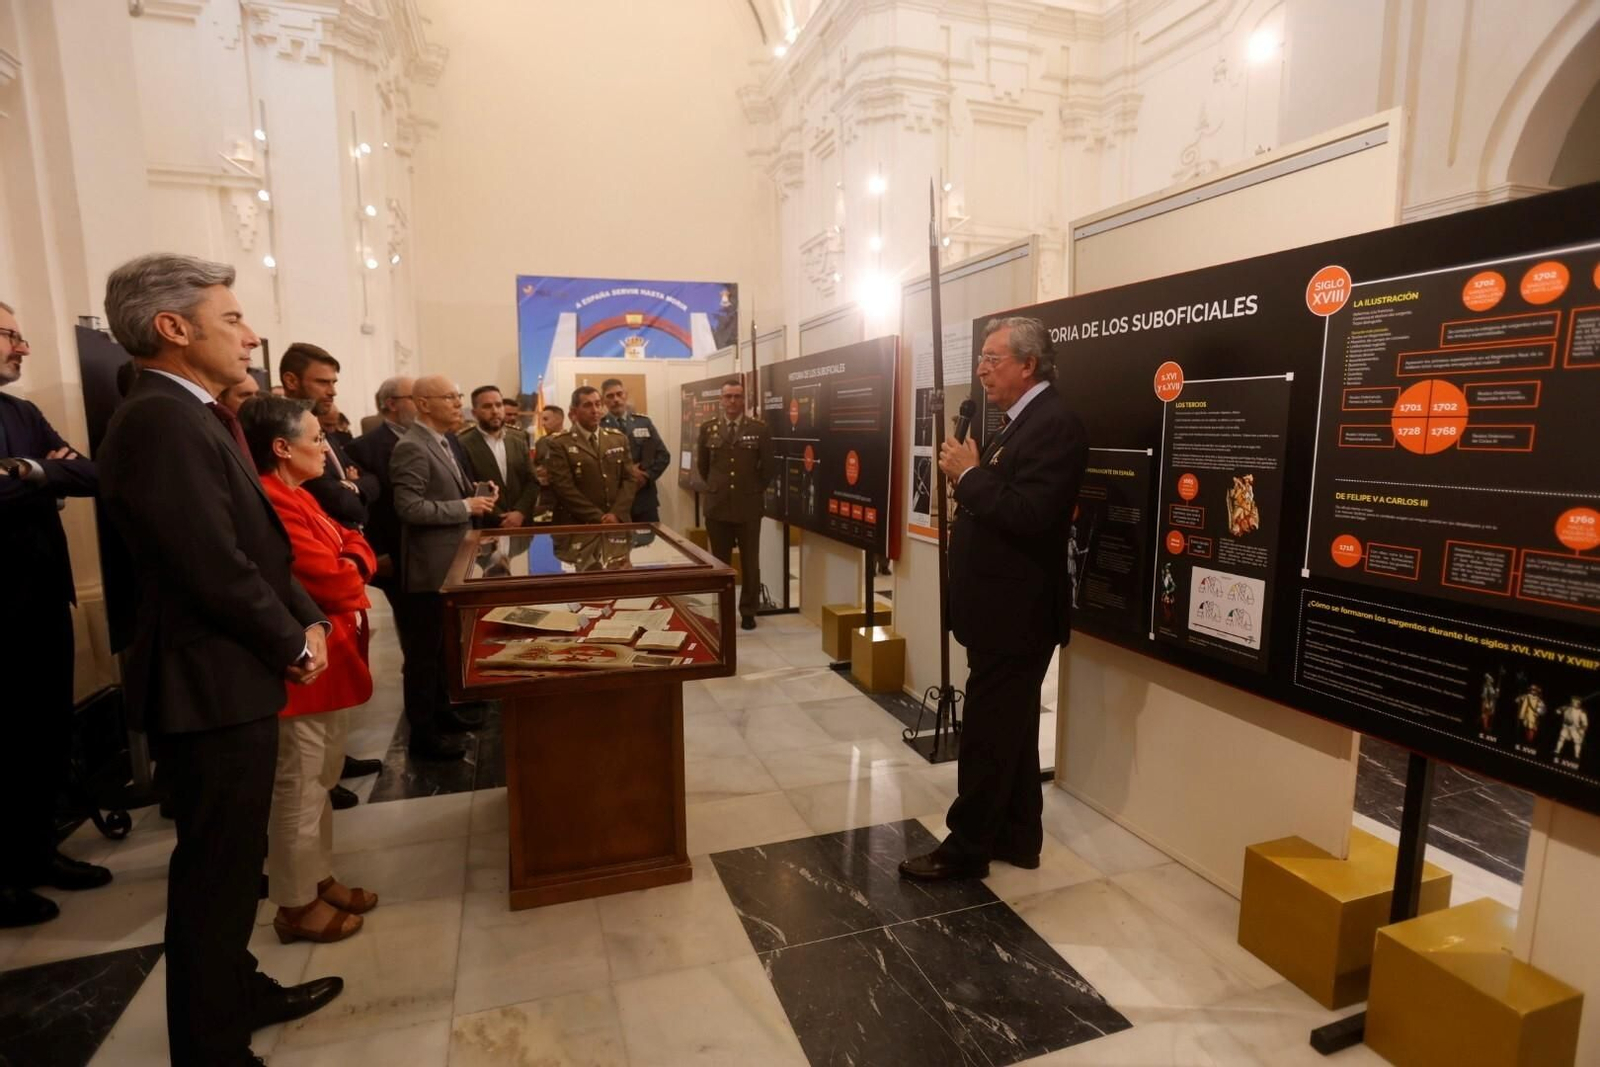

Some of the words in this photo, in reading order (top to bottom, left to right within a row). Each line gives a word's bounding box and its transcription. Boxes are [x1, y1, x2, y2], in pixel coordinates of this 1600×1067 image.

[1315, 278, 1344, 291] SIGLO
[581, 290, 611, 306] ESPAÑA
[611, 288, 639, 296] SERVIR
[1312, 289, 1344, 305] XVIII
[1353, 300, 1363, 308] LA
[1364, 291, 1419, 306] ILUSTRACIÓN
[1048, 325, 1079, 343] ORIA
[1082, 321, 1099, 339] DE
[1101, 316, 1129, 337] LOS
[1131, 294, 1259, 332] SUBOFICIALES
[1400, 403, 1422, 412] 1701
[1433, 403, 1458, 411] 1702
[1398, 427, 1421, 436] 1728
[1431, 427, 1456, 436] 1768
[1346, 493, 1372, 503] FELIPE
[1372, 495, 1379, 503] V
[1386, 497, 1419, 506] CARLOS
[1420, 499, 1428, 507] III
[1307, 600, 1330, 611] ¿Cómo
[1331, 604, 1340, 612] se
[1340, 606, 1374, 620] formaron
[1374, 613, 1387, 623] los
[1387, 616, 1427, 633] sargentos
[1428, 625, 1463, 641] durante
[1465, 633, 1479, 643] los
[1480, 637, 1509, 651] siglos
[1511, 643, 1531, 657] XVI,
[1533, 648, 1554, 661] XVII
[1557, 653, 1565, 663] Y
[1567, 655, 1600, 670] XVIII?
